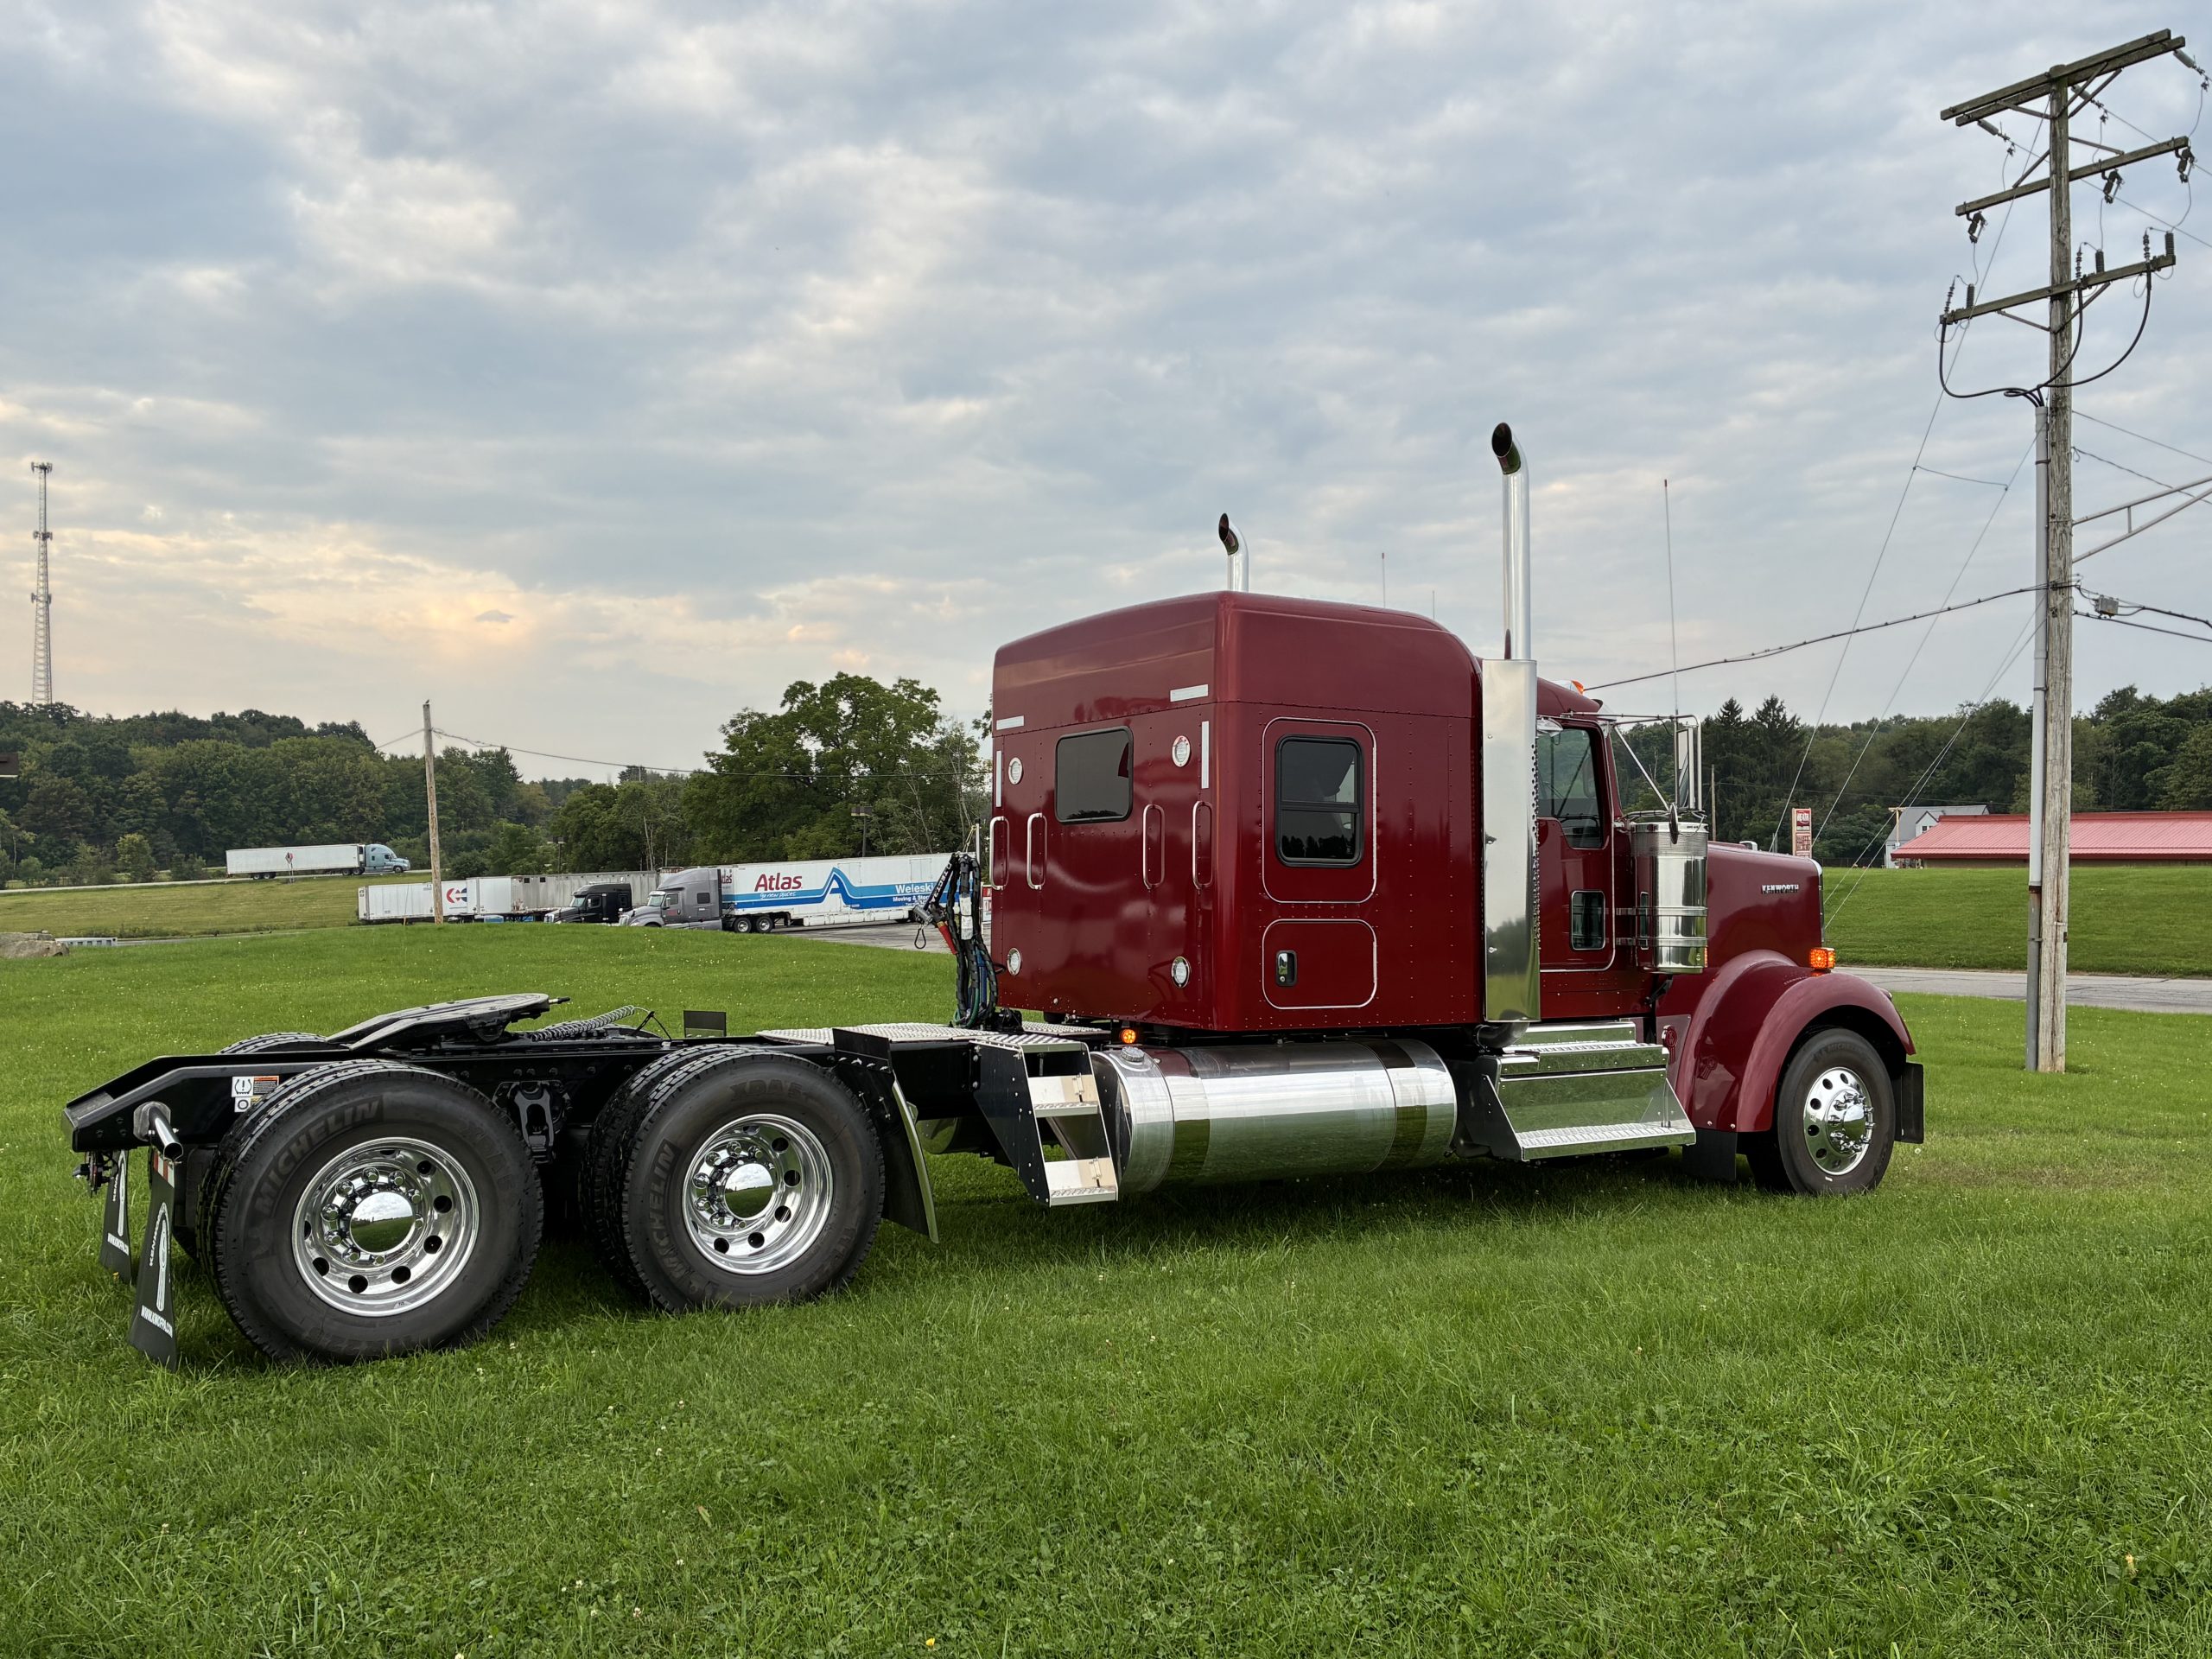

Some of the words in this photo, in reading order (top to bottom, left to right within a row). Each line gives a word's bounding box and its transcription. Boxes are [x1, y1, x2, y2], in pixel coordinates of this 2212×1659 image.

[754, 873, 803, 892] Atlas
[1762, 884, 1800, 893] KENWORTH
[254, 1099, 380, 1213] MICHELIN
[648, 1142, 686, 1280] MICHELIN
